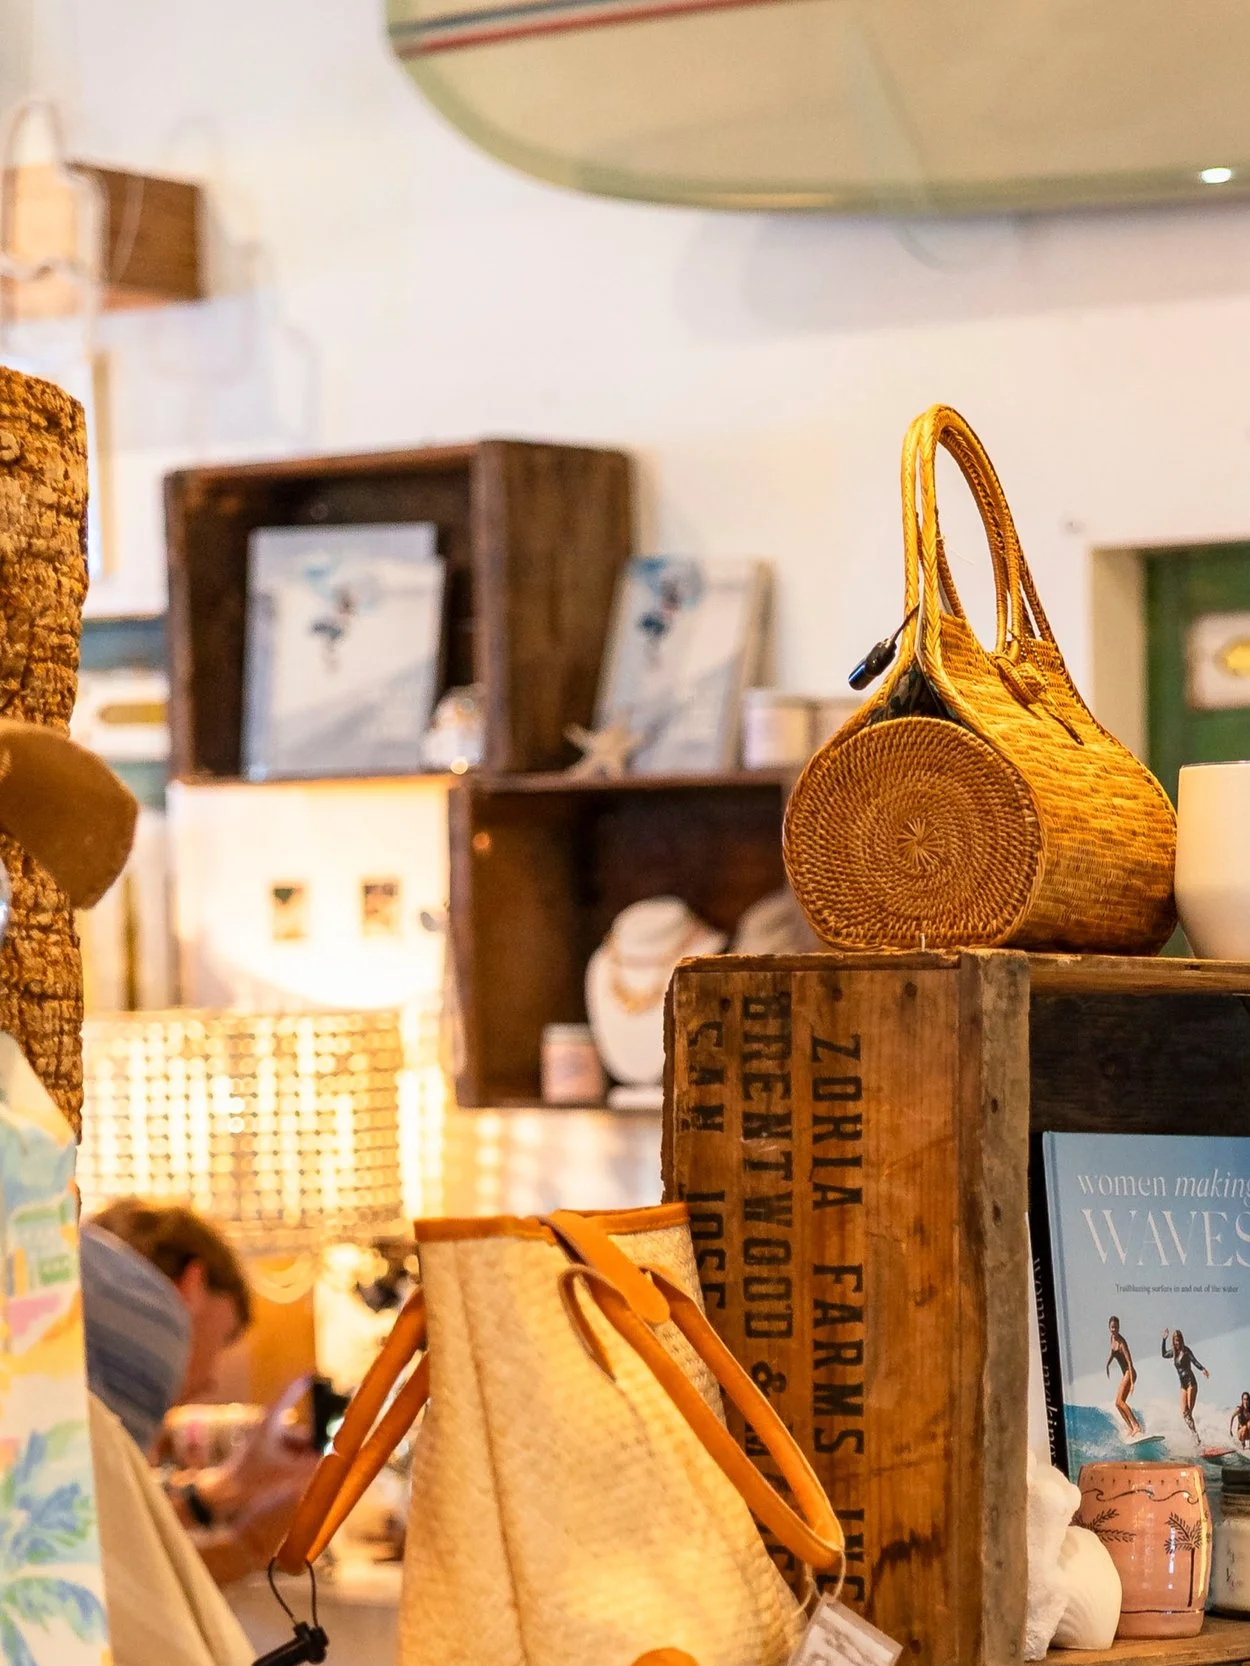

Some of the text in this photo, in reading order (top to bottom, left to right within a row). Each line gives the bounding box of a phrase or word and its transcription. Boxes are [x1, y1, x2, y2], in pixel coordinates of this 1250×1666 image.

[742, 992, 794, 1341] BRENTWOOD
[811, 1033, 864, 1212] ZORIA
[1077, 1174, 1166, 1197] women
[751, 1361, 788, 1398] &
[811, 1263, 864, 1456] FARMS
